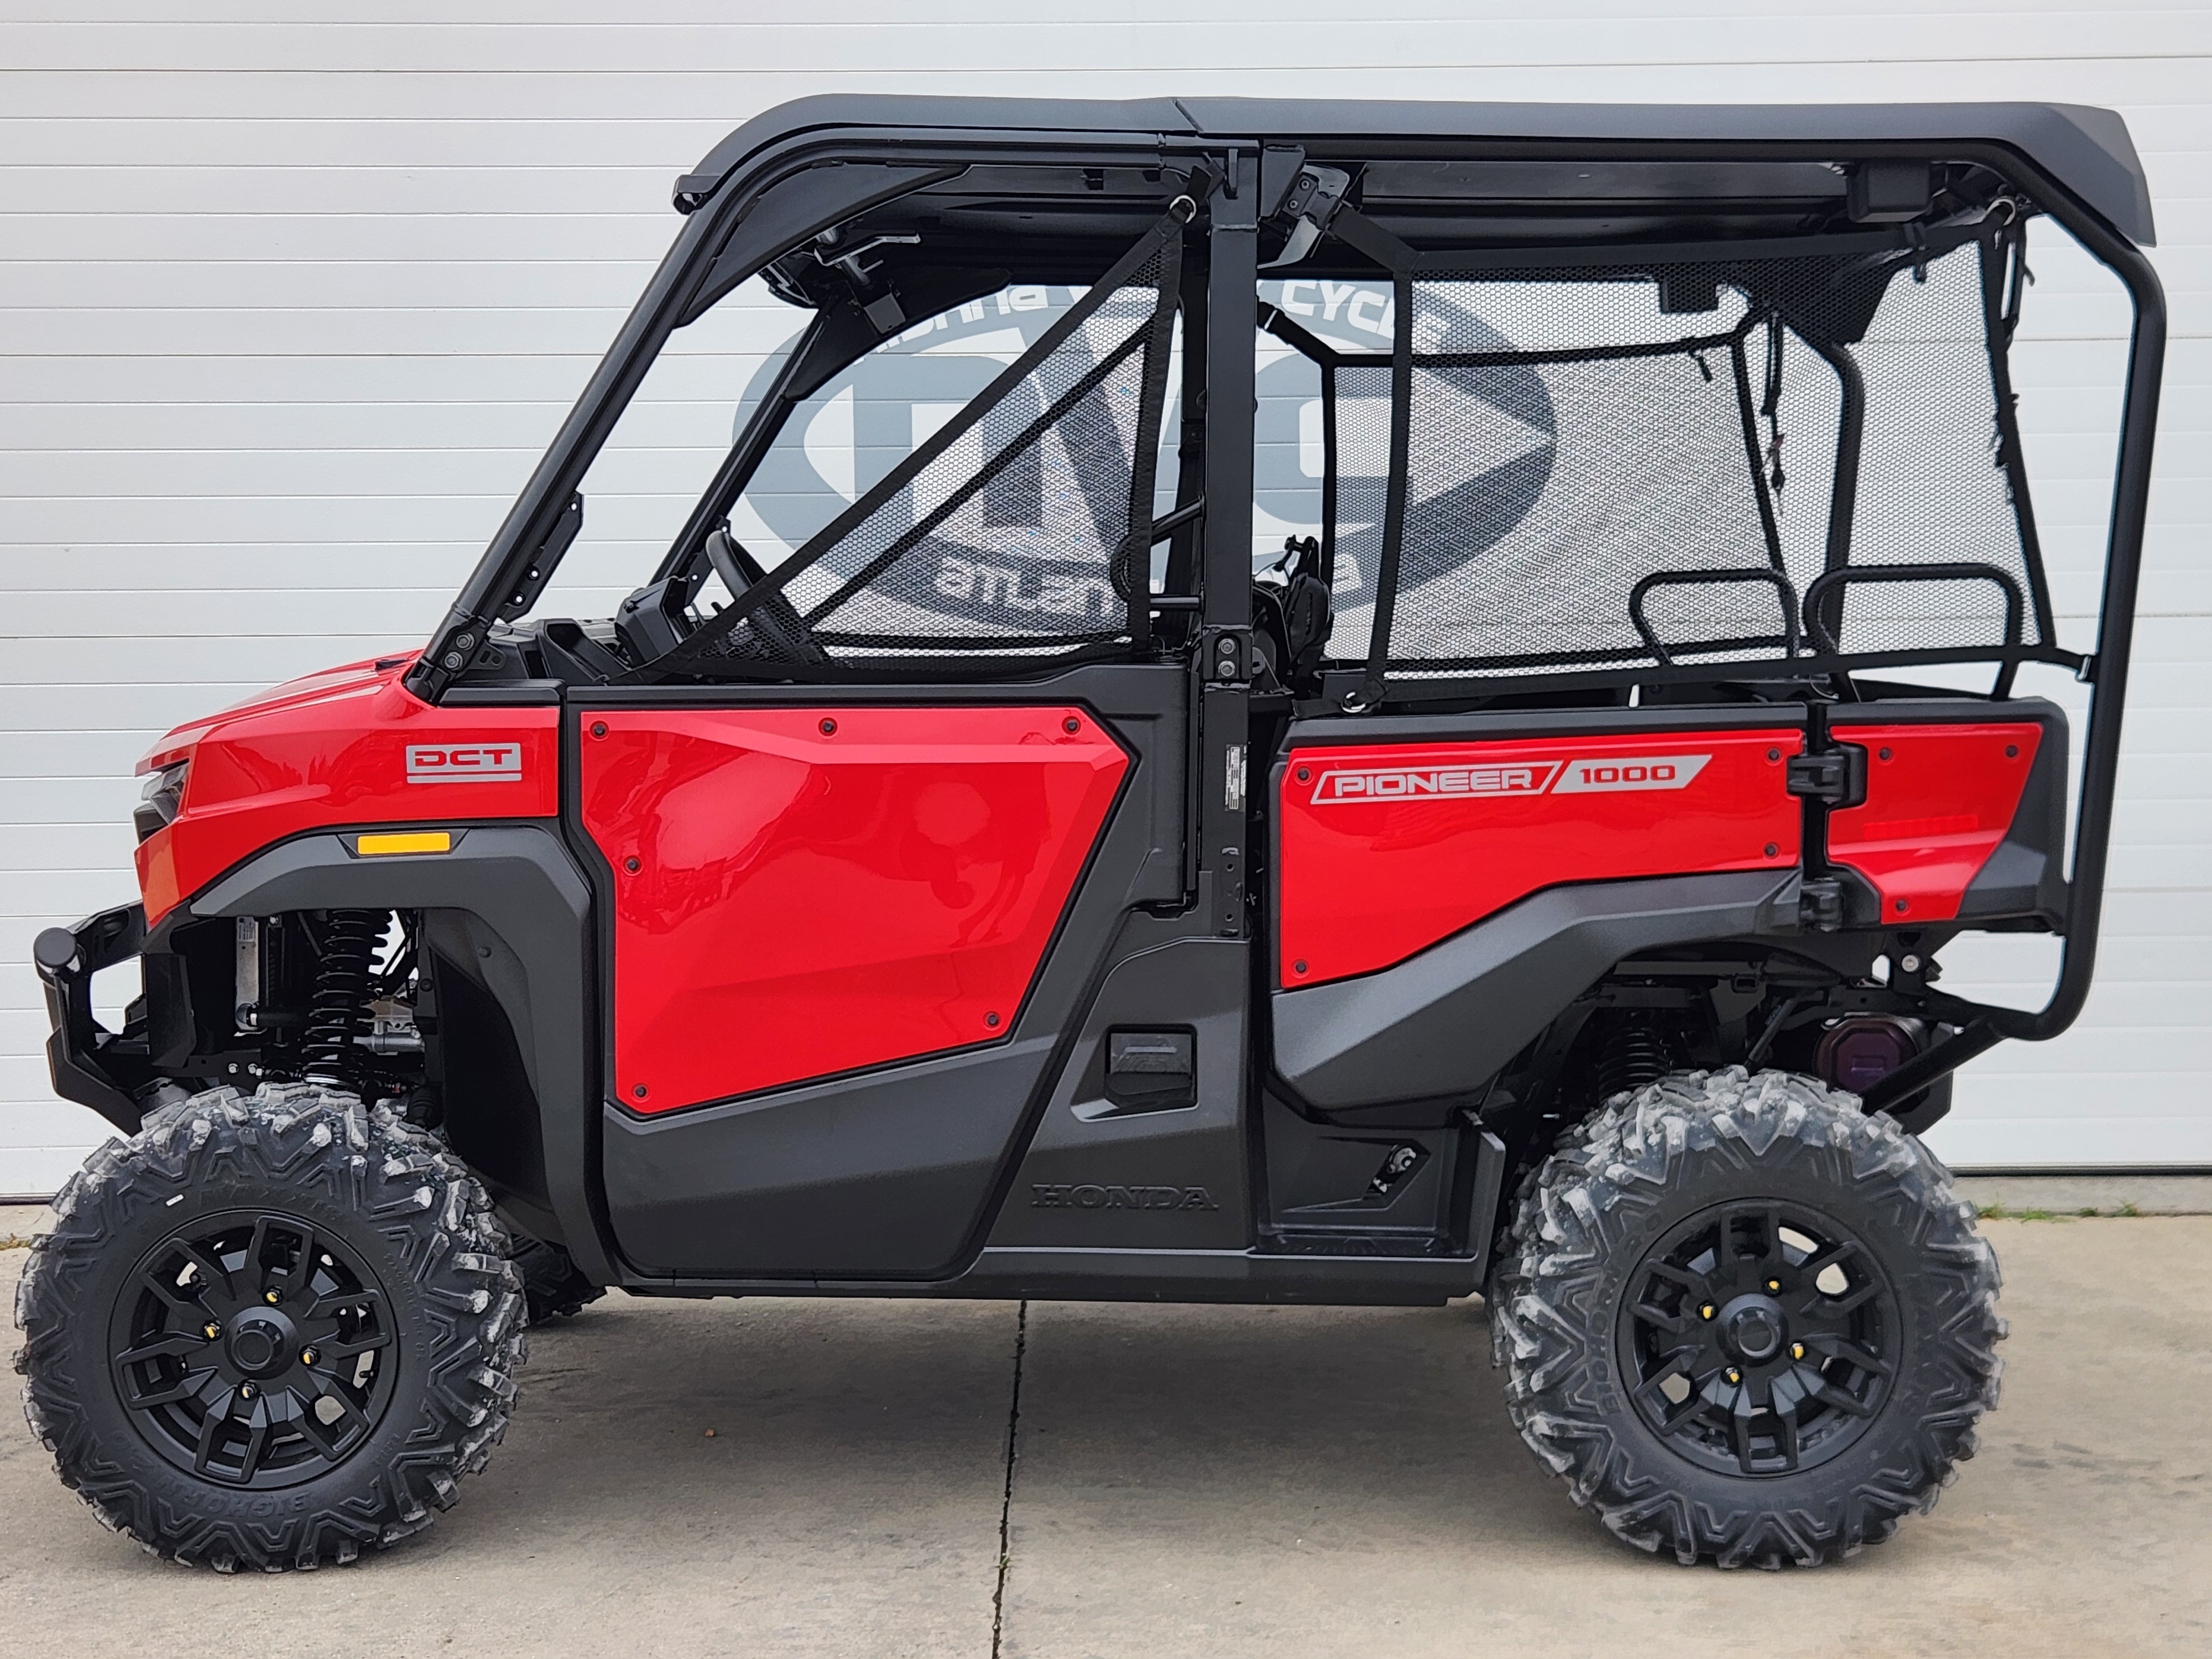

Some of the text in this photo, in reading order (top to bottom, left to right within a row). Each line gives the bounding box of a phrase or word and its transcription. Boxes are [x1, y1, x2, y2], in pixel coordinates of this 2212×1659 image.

[415, 749, 513, 767] DCT
[1334, 764, 1677, 797] PIONEER 1000
[1031, 1183, 1220, 1211] HONDA
